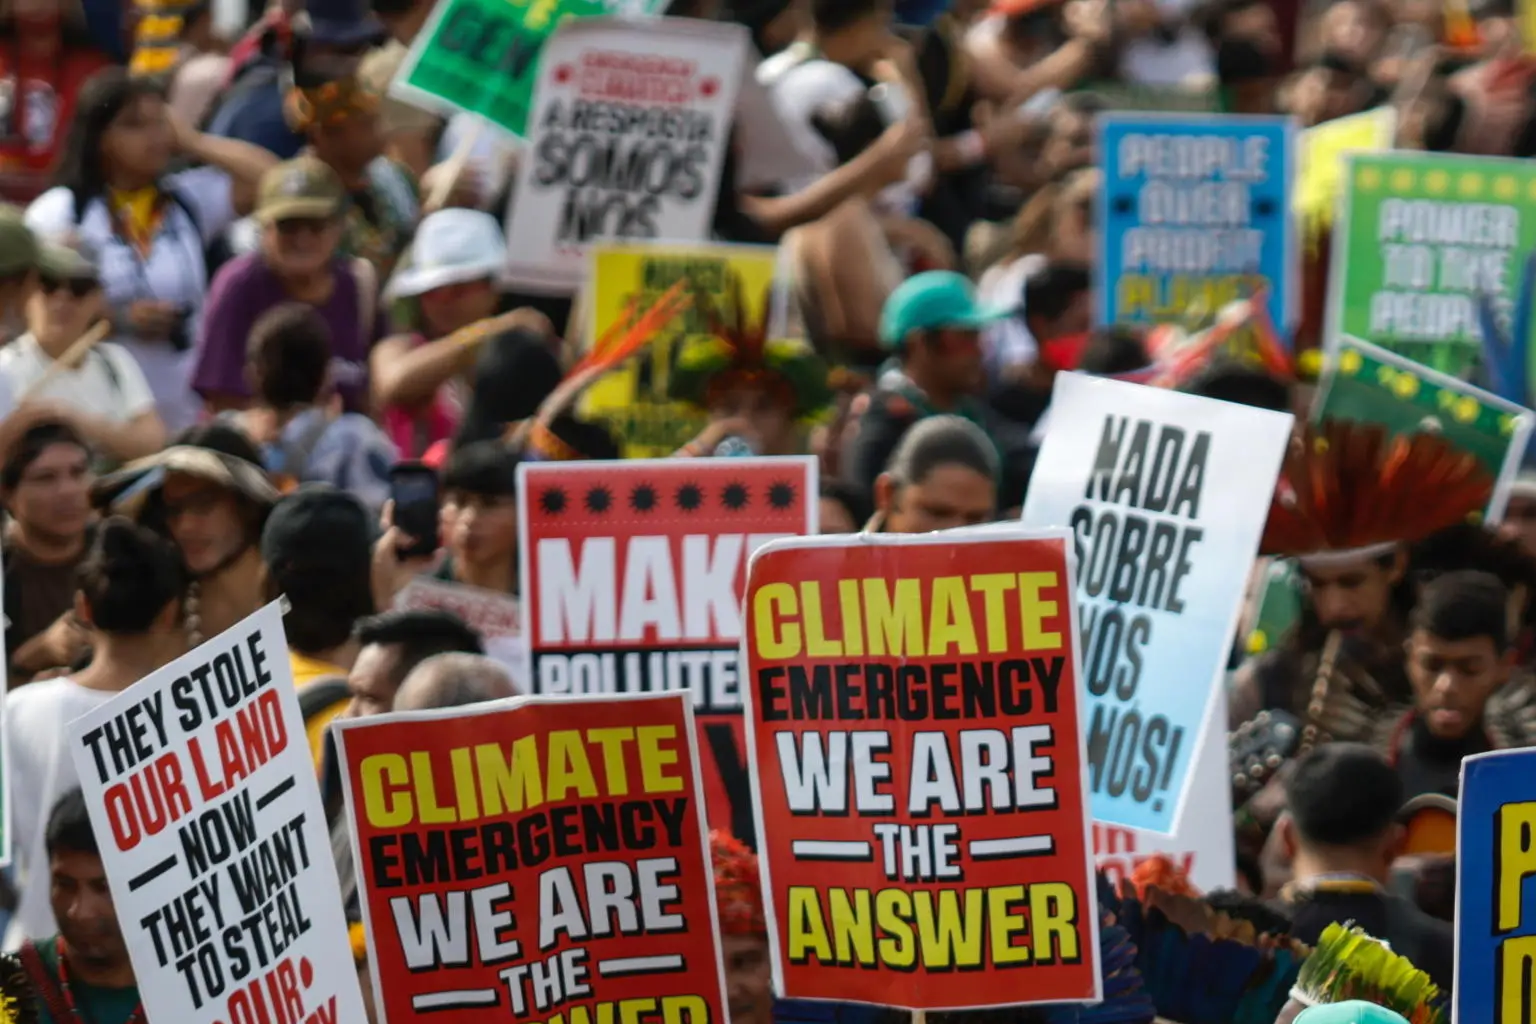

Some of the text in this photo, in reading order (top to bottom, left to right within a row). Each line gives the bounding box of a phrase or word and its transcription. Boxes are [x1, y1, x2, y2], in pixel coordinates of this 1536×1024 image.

[534, 131, 710, 200] SOMOS
[1118, 134, 1271, 178] PEOPLE
[1139, 181, 1252, 227] OVER
[1378, 198, 1520, 248] POWER
[1121, 228, 1264, 272] PROFIT
[1381, 244, 1512, 293] TO THE
[1085, 413, 1213, 520] NADA
[538, 532, 768, 644] MAK
[1070, 503, 1204, 615] SOBRE
[753, 570, 1062, 660] CLIMATE
[82, 630, 273, 784] THEY STOLE
[538, 651, 744, 708] POLLUTE
[757, 655, 1065, 722] EMERGENCY
[103, 686, 289, 854] OUR LAND
[360, 724, 685, 829] CLIMATE
[774, 729, 896, 816] WE
[907, 722, 1058, 817] ARE
[178, 788, 258, 881] NOW
[369, 797, 690, 888] EMERGENCY
[873, 822, 963, 882] THE
[140, 812, 311, 968] THEY WANT
[389, 857, 690, 972] WE ARE
[787, 881, 1082, 973] ANSWER
[176, 882, 312, 1011] TO STEAL
[498, 947, 593, 1015] THE
